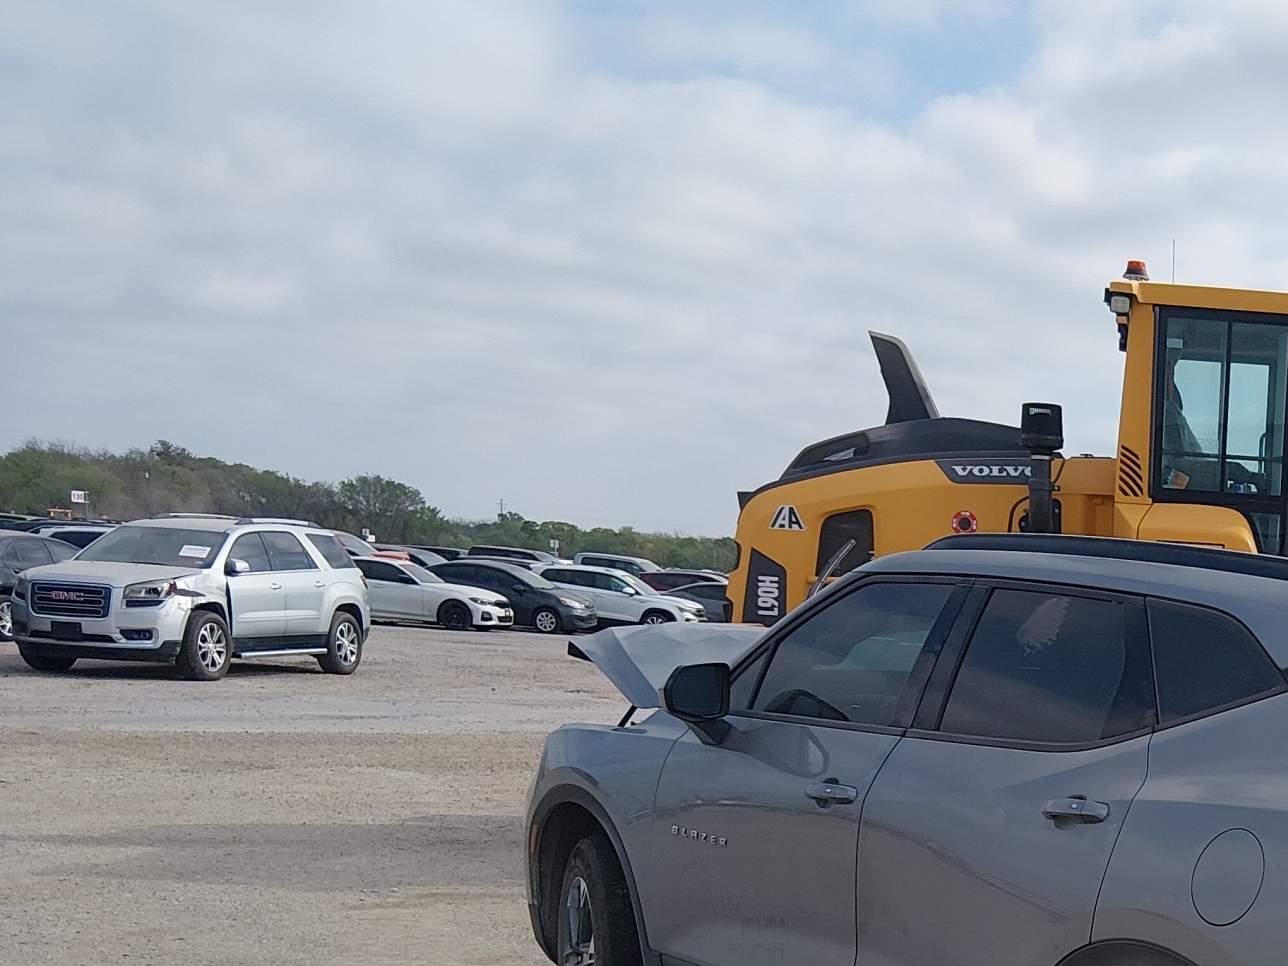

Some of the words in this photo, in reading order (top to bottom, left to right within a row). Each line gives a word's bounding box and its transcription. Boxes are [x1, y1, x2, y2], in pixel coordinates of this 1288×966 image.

[51, 590, 84, 601] GMC
[757, 575, 779, 617] L90H
[671, 824, 728, 848] BLAZER
